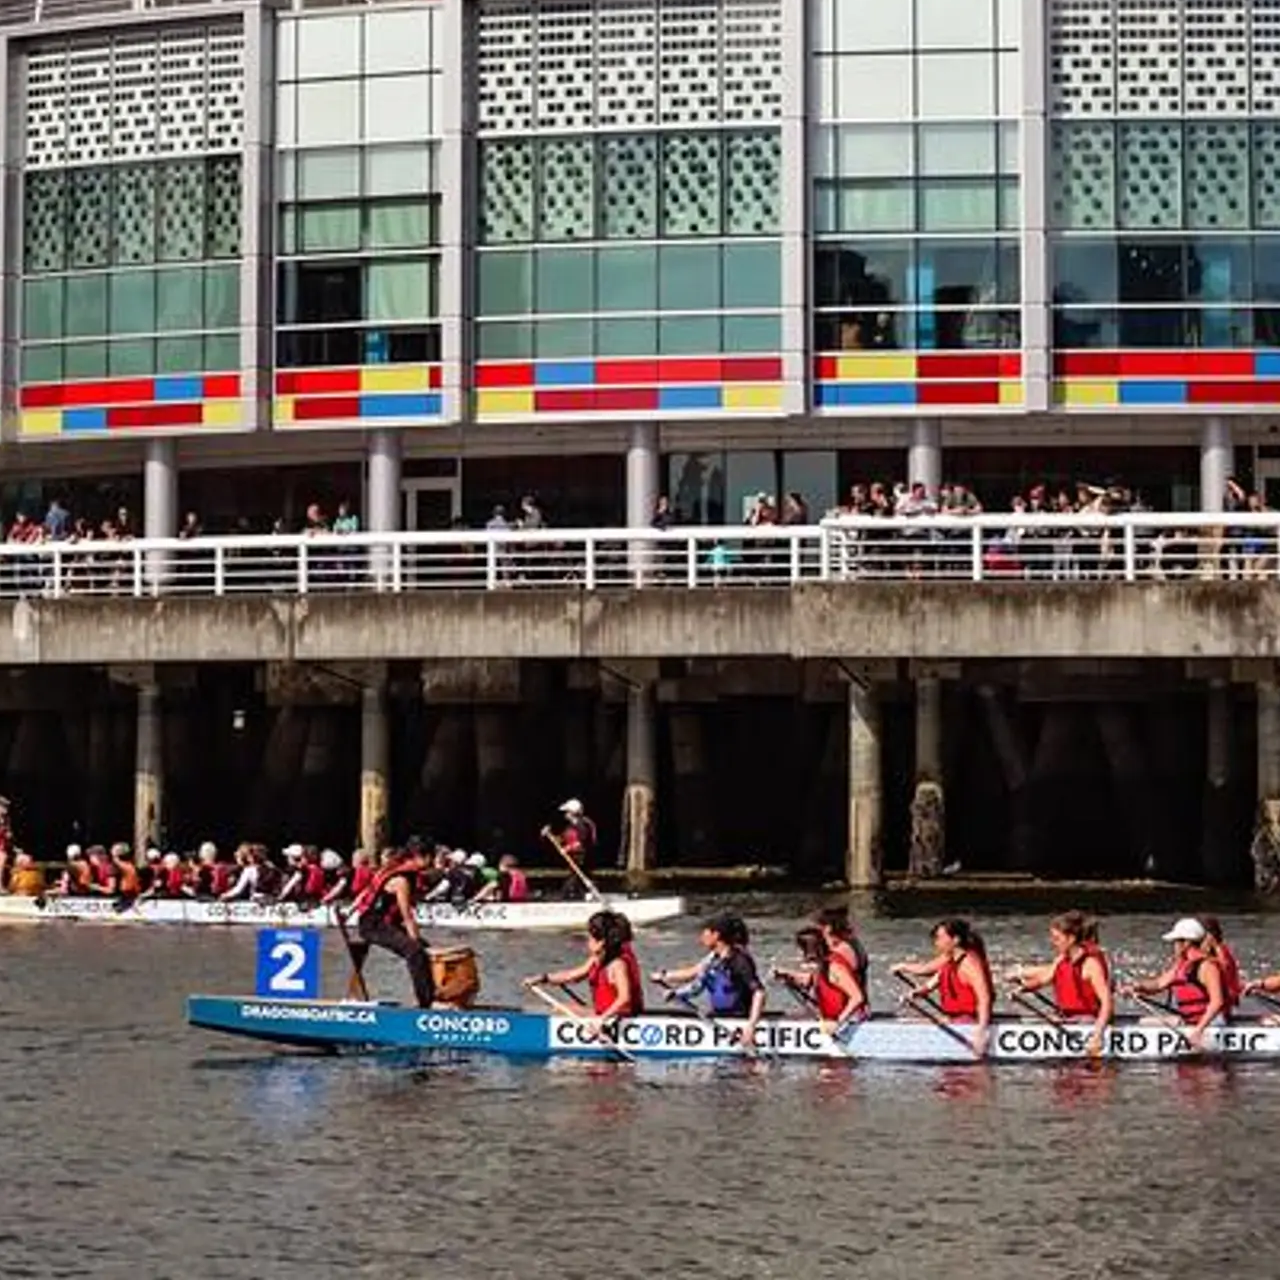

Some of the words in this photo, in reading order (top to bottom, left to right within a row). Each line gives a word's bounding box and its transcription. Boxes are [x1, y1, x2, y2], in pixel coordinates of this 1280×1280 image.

[270, 944, 306, 991] 2
[240, 1004, 379, 1024] DRAGONBOATBC.CA
[416, 1014, 511, 1034] CONCORD
[556, 1021, 706, 1046] CONCORD
[713, 1024, 822, 1049] PACIFIC
[998, 1029, 1148, 1053] CONCRD
